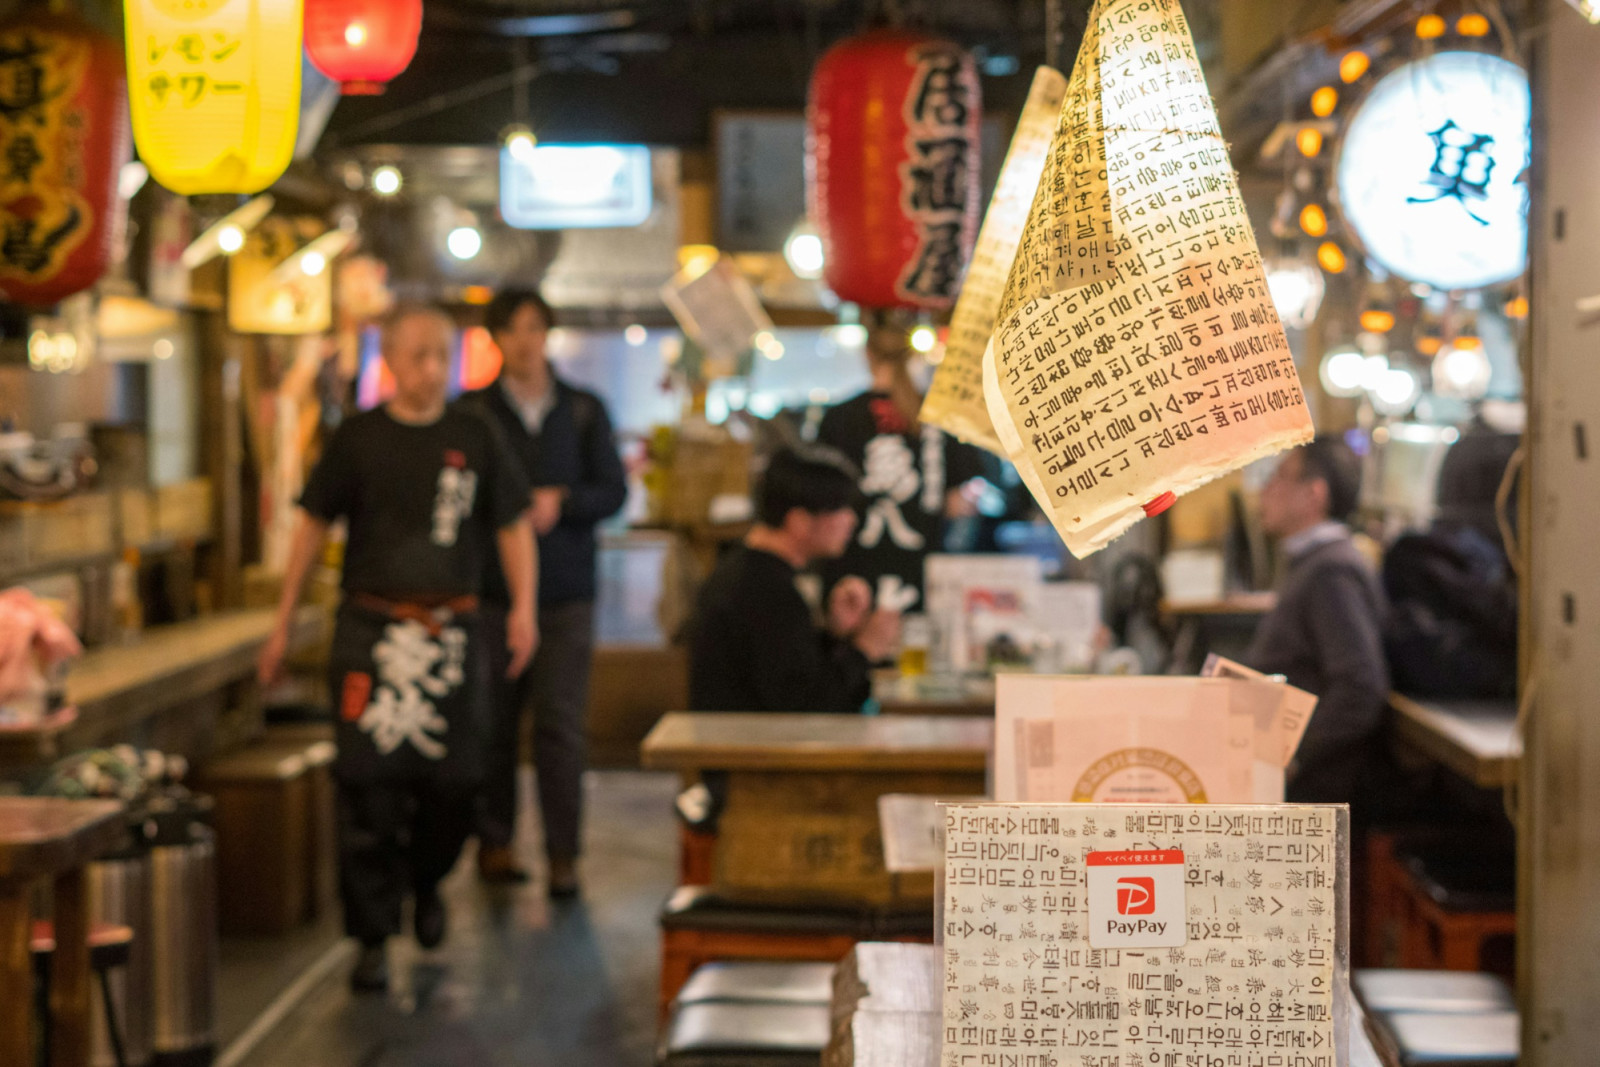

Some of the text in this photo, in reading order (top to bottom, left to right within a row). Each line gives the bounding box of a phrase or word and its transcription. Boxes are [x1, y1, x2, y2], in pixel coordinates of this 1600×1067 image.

[149, 36, 239, 60] レモン
[149, 75, 242, 102] サワー
[1105, 854, 1165, 862] ペイペイ使えます
[1107, 919, 1167, 936] PayPay
